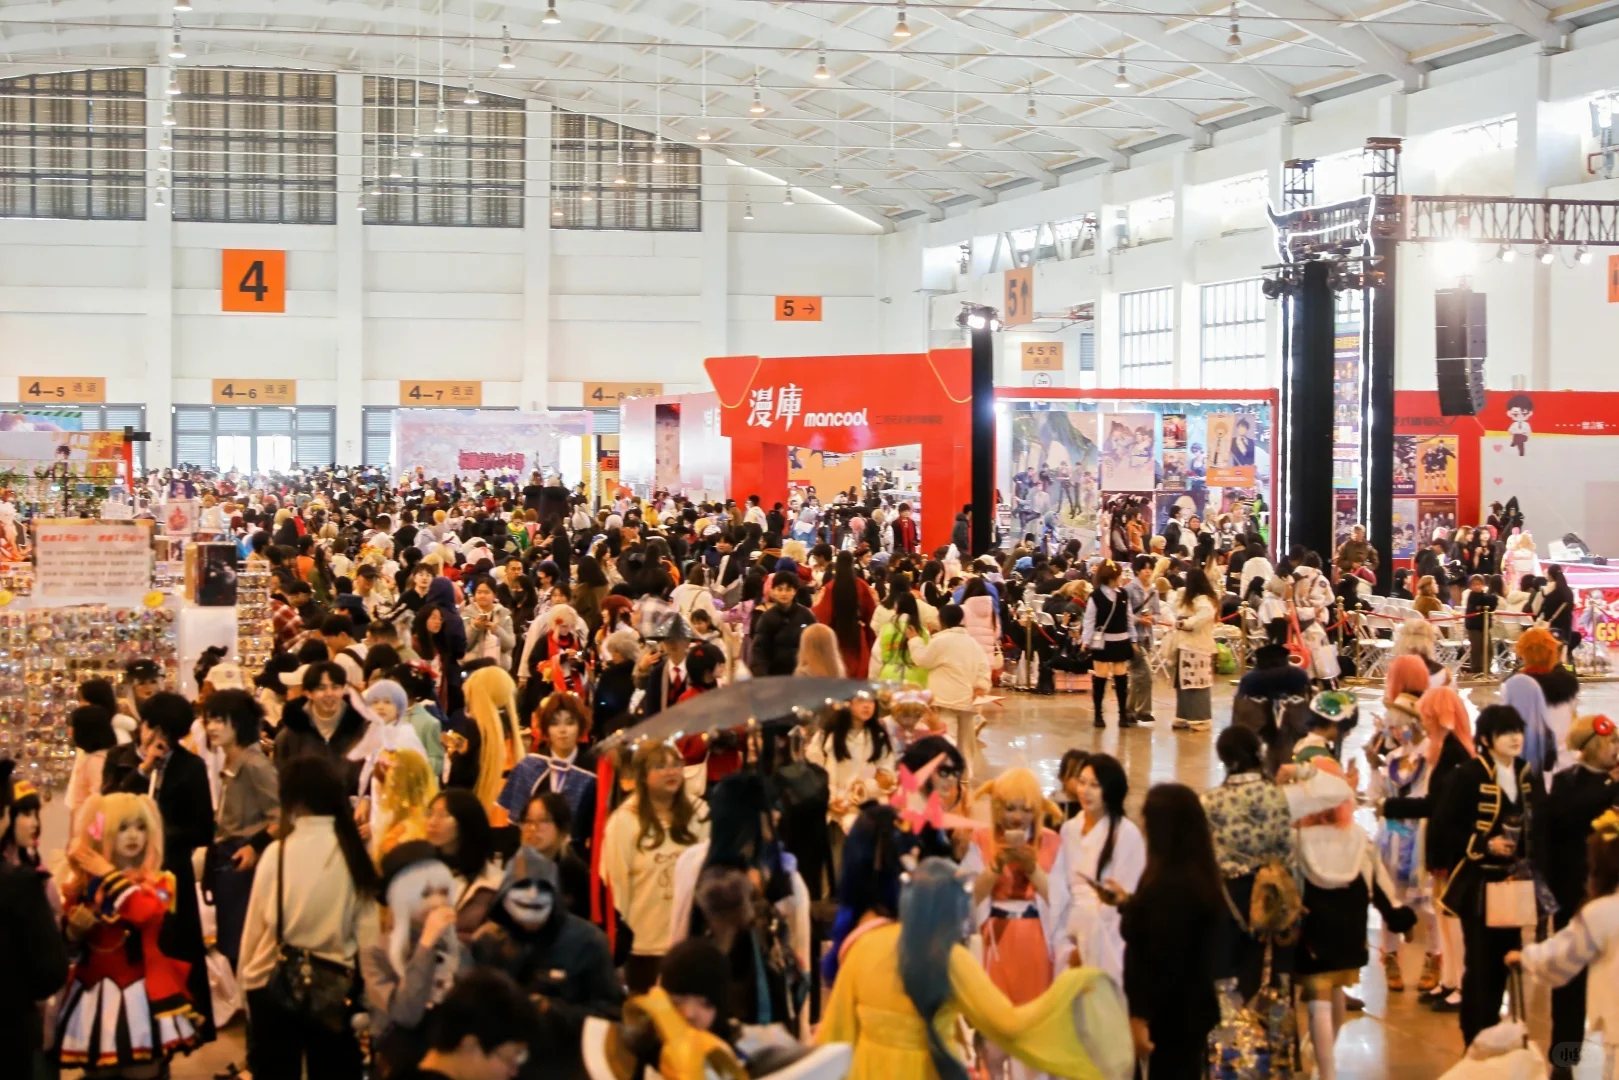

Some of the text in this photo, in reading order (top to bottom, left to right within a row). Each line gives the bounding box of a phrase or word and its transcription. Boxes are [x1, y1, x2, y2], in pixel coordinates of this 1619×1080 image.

[239, 260, 268, 301] 4
[783, 299, 795, 317] 5
[1008, 279, 1017, 317] 5
[747, 383, 803, 432] 漫庫
[803, 408, 868, 427] mancool
[1596, 622, 1619, 642] GS
